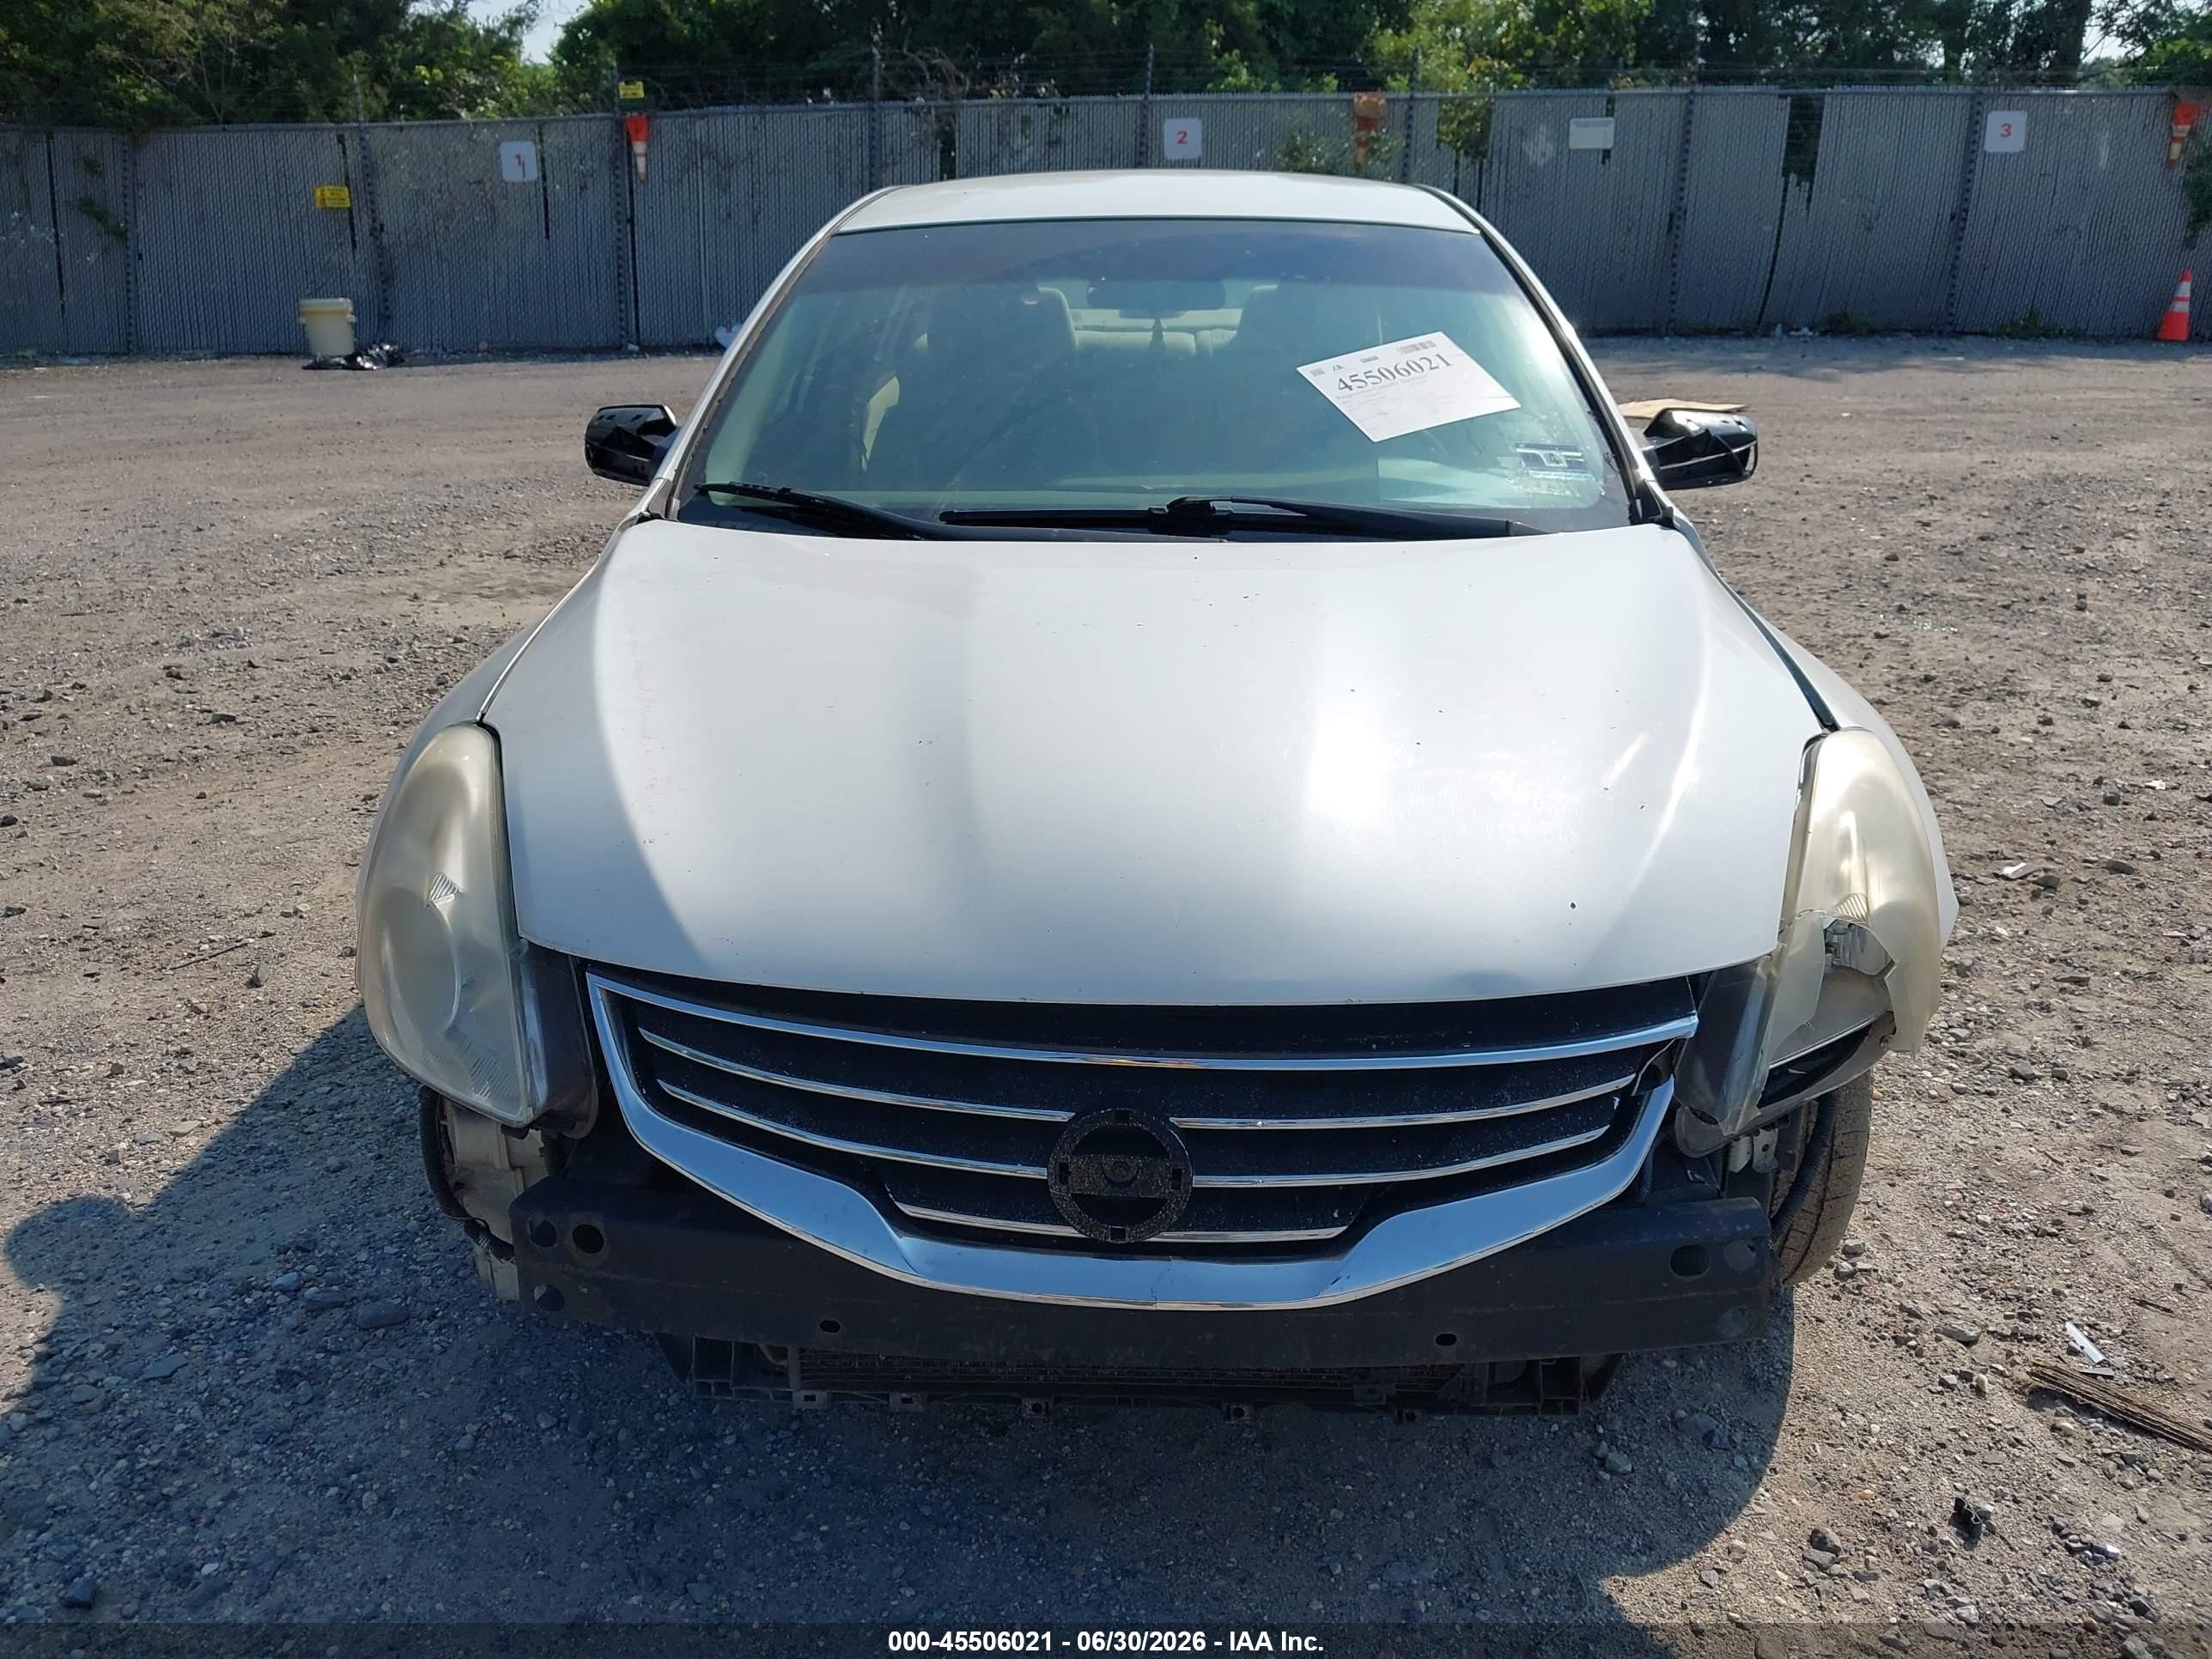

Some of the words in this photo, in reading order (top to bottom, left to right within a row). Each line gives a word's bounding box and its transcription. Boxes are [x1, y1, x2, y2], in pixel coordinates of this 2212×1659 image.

[1176, 130, 1188, 145] 2
[2000, 123, 2012, 137] 3
[1337, 353, 1452, 392] 45506021
